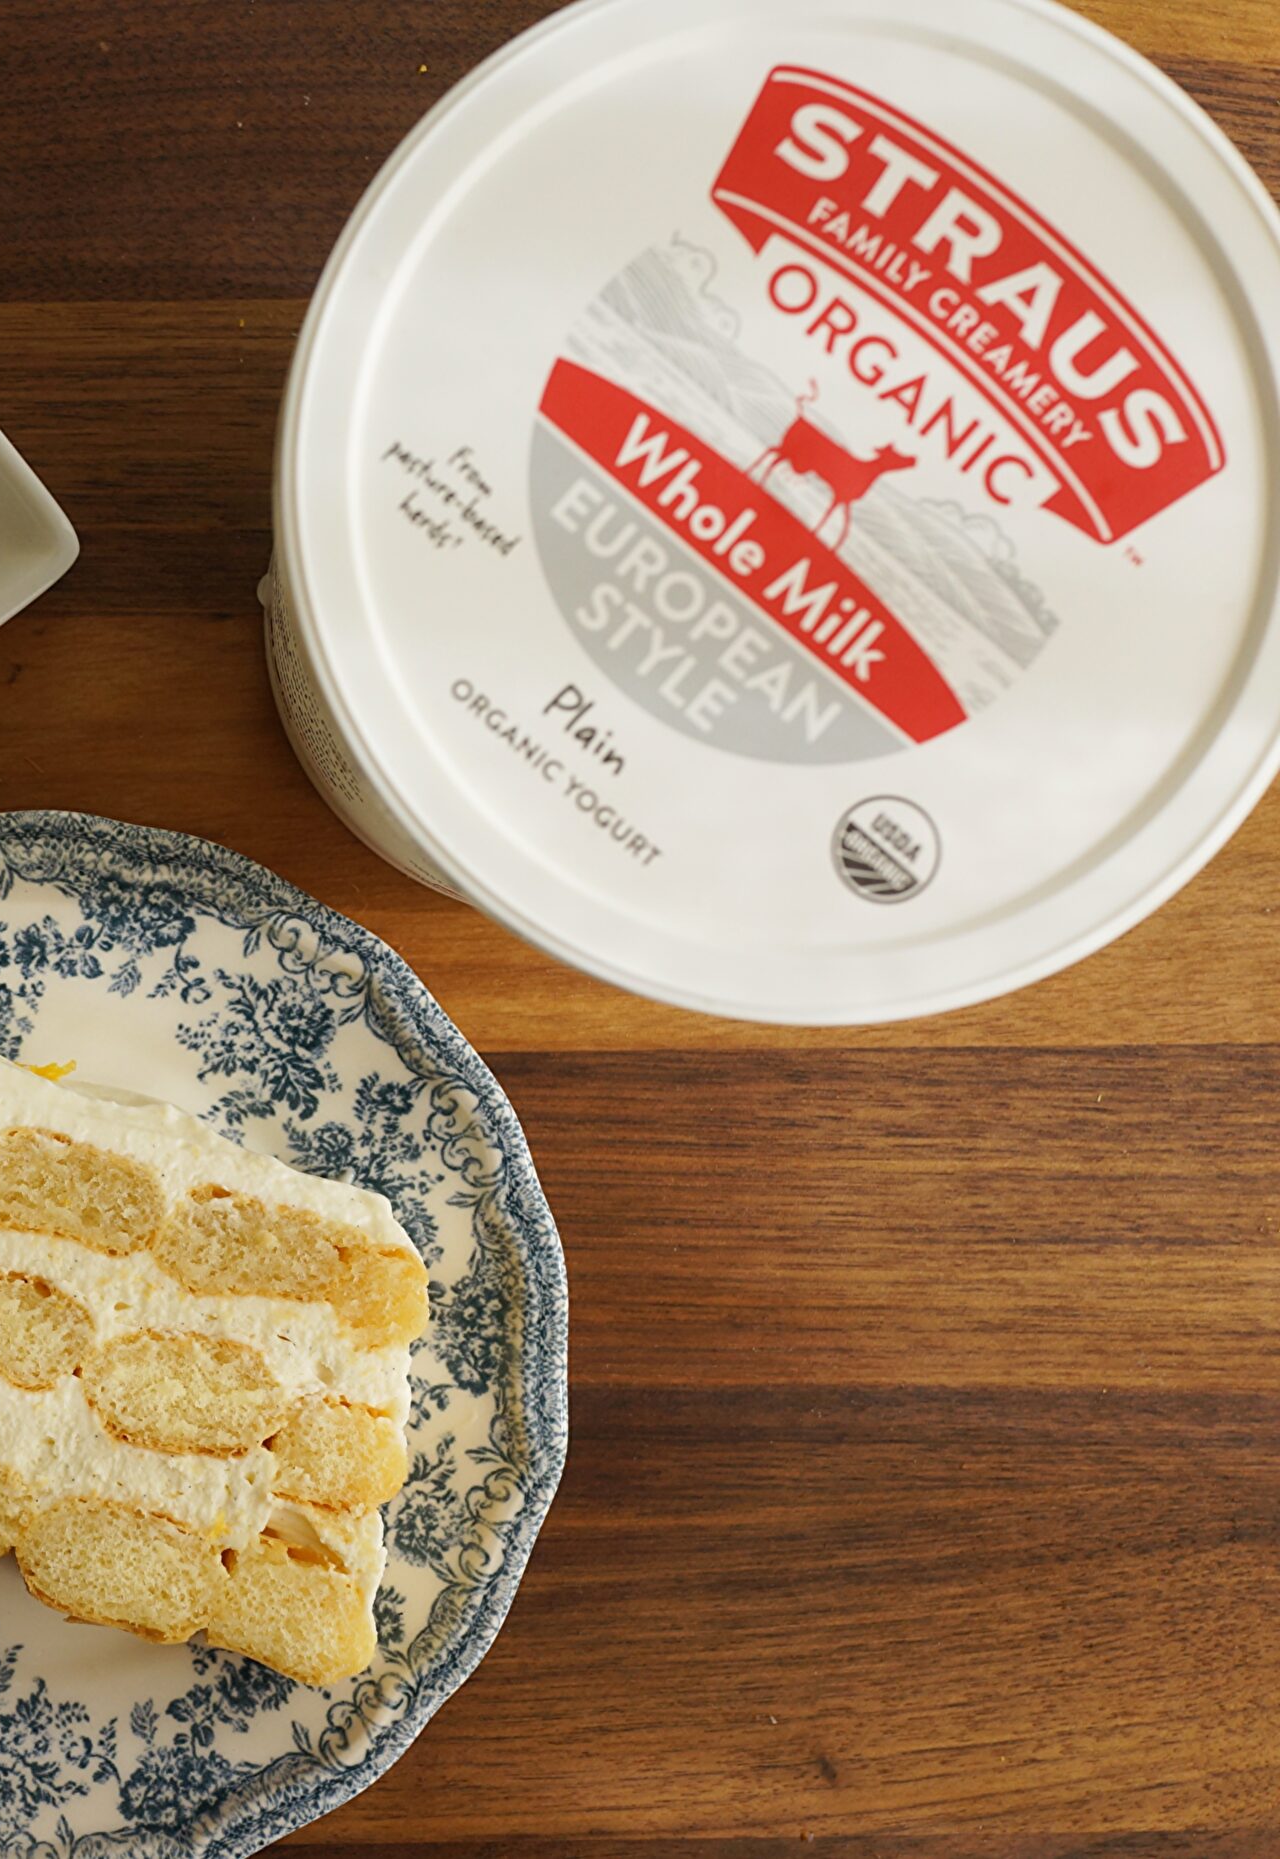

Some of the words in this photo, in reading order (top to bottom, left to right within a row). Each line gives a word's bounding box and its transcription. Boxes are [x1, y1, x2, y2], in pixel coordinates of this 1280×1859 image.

[767, 263, 1034, 506] ORGANIC
[774, 103, 1188, 470] STRAUS
[806, 196, 932, 292] FAMILY
[928, 287, 1092, 449] CREAMERY
[447, 445, 492, 495] From
[614, 412, 766, 576] Whole
[762, 557, 887, 682] Milk
[549, 477, 843, 744] EUROPEAN
[575, 582, 738, 734] STYLE
[450, 678, 565, 783] ORGANIC
[563, 774, 663, 868] YOGURT
[542, 683, 627, 776] Plain
[871, 812, 922, 862] USDA
